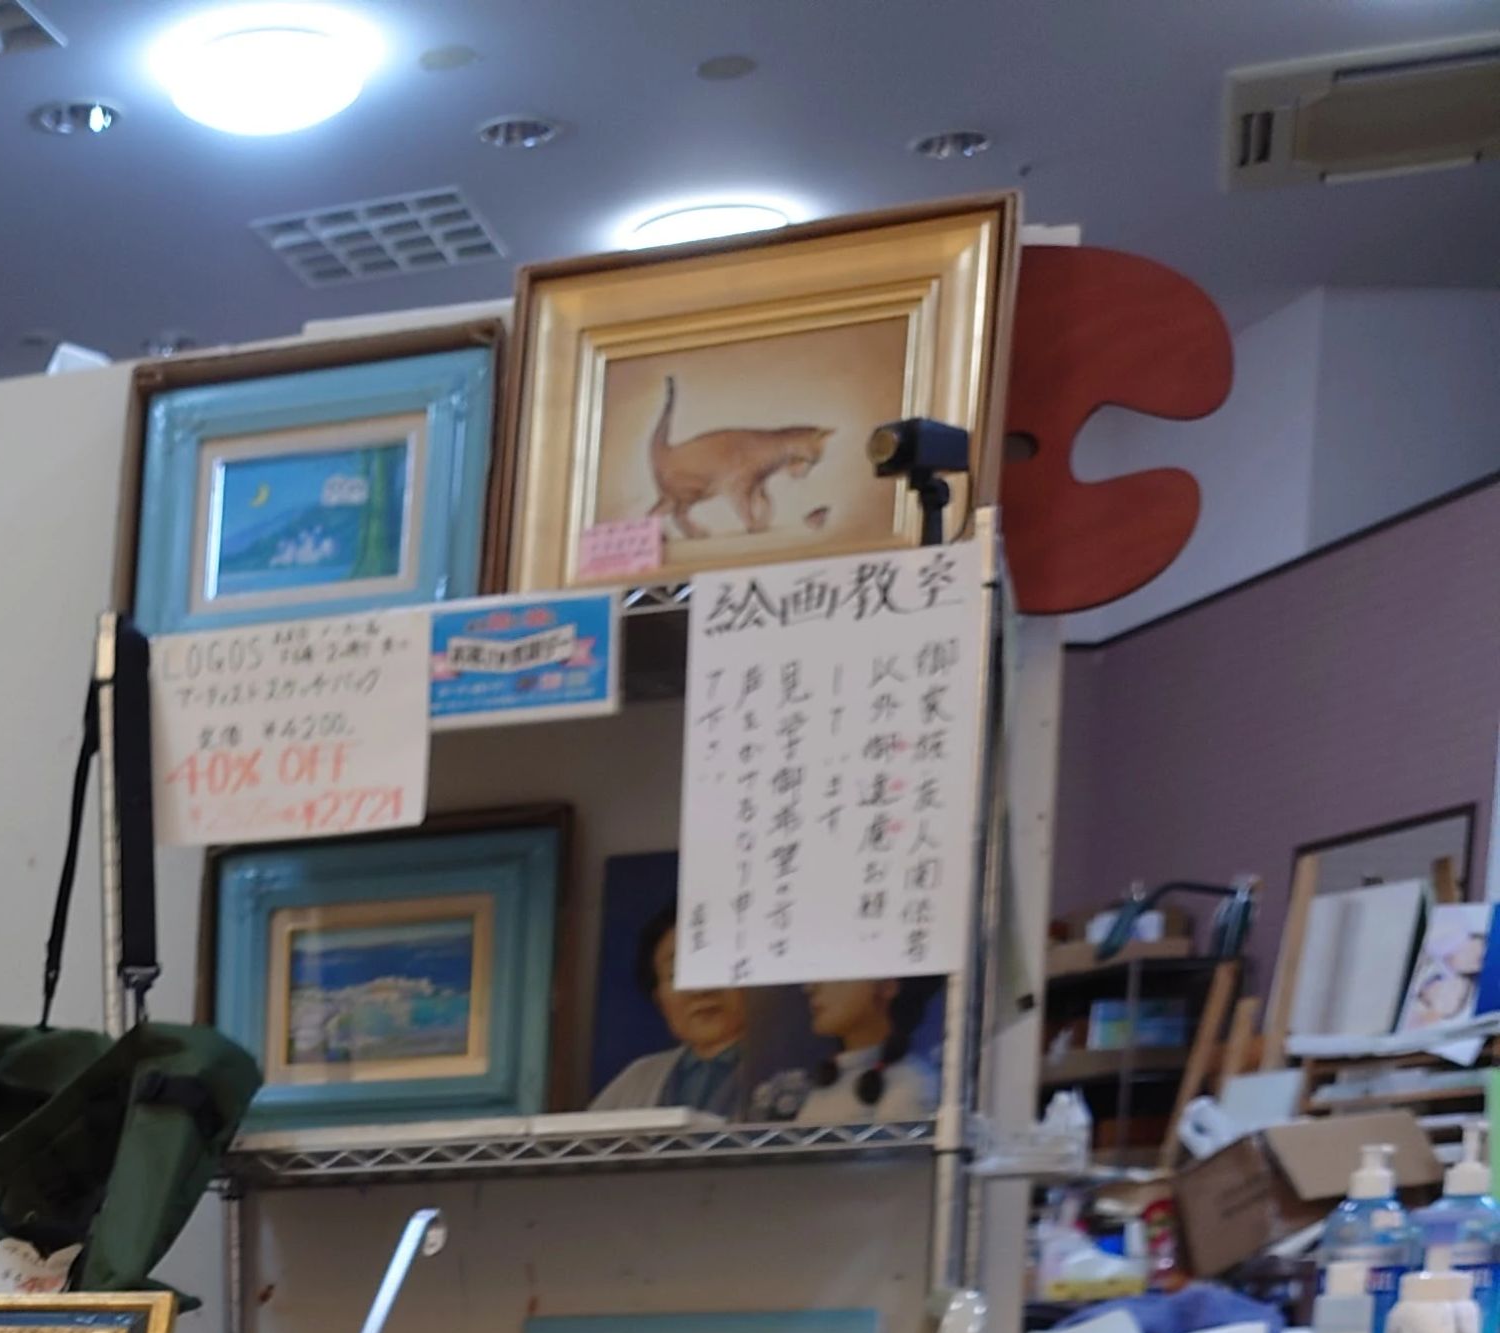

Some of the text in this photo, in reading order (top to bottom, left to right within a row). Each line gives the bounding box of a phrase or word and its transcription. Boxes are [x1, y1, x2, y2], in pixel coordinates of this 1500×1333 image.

[703, 552, 965, 638] 絵画教室
[162, 637, 263, 682] LOGOS
[278, 740, 363, 787] OFF
